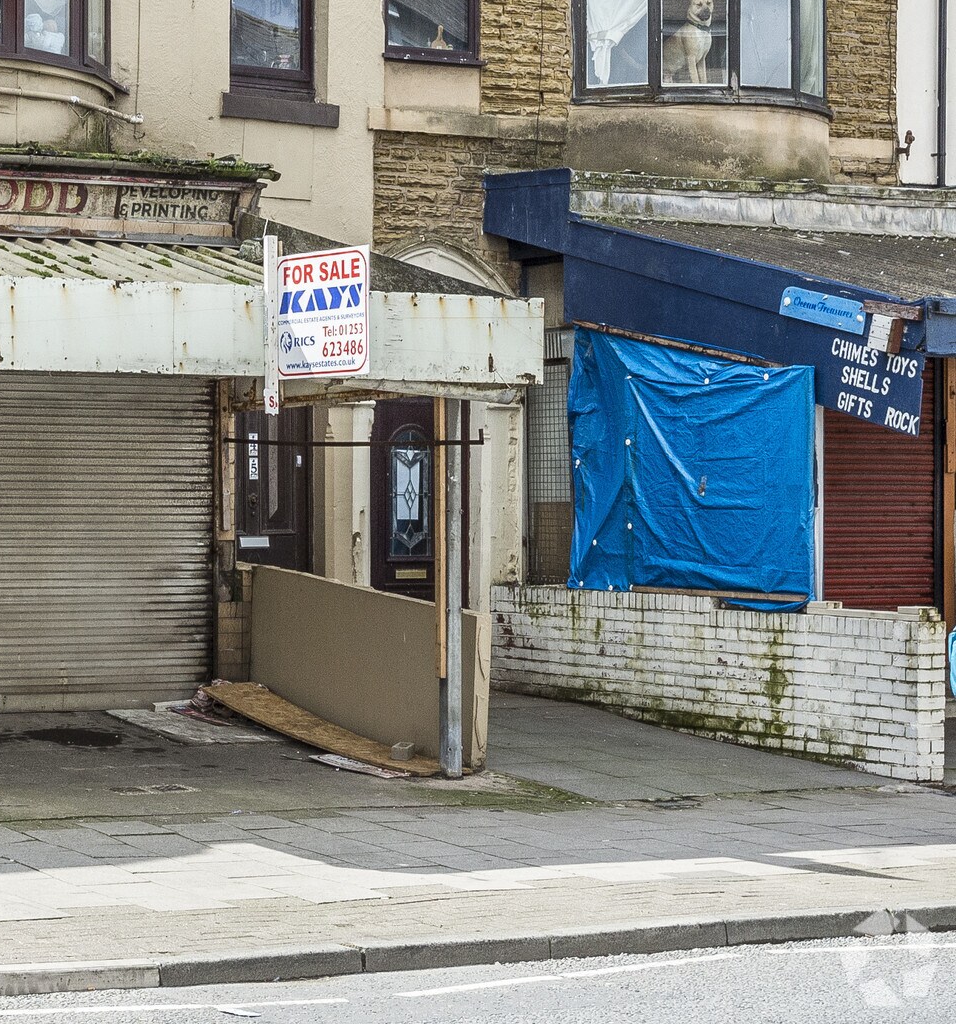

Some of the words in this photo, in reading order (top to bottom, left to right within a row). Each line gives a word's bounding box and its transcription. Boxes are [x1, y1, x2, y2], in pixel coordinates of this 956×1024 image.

[121, 185, 219, 202] DEVELOPING
[131, 202, 208, 219] PRINTING
[283, 263, 314, 286] FOR
[319, 258, 360, 282] SALE
[279, 283, 363, 315] KAYS
[793, 296, 817, 311] Ocean
[817, 302, 853, 319] Treasures
[304, 316, 319, 324] ESTATE
[338, 323, 364, 336] 01253
[294, 335, 315, 347] RICS
[322, 339, 364, 357] 623486
[286, 357, 356, 371] www.kaysestates.co.uk
[831, 337, 879, 367] CHIMES
[886, 353, 918, 378] TOYS
[841, 366, 891, 396] SHELLS
[837, 392, 873, 419] GIFTS
[884, 406, 920, 436] ROCK
